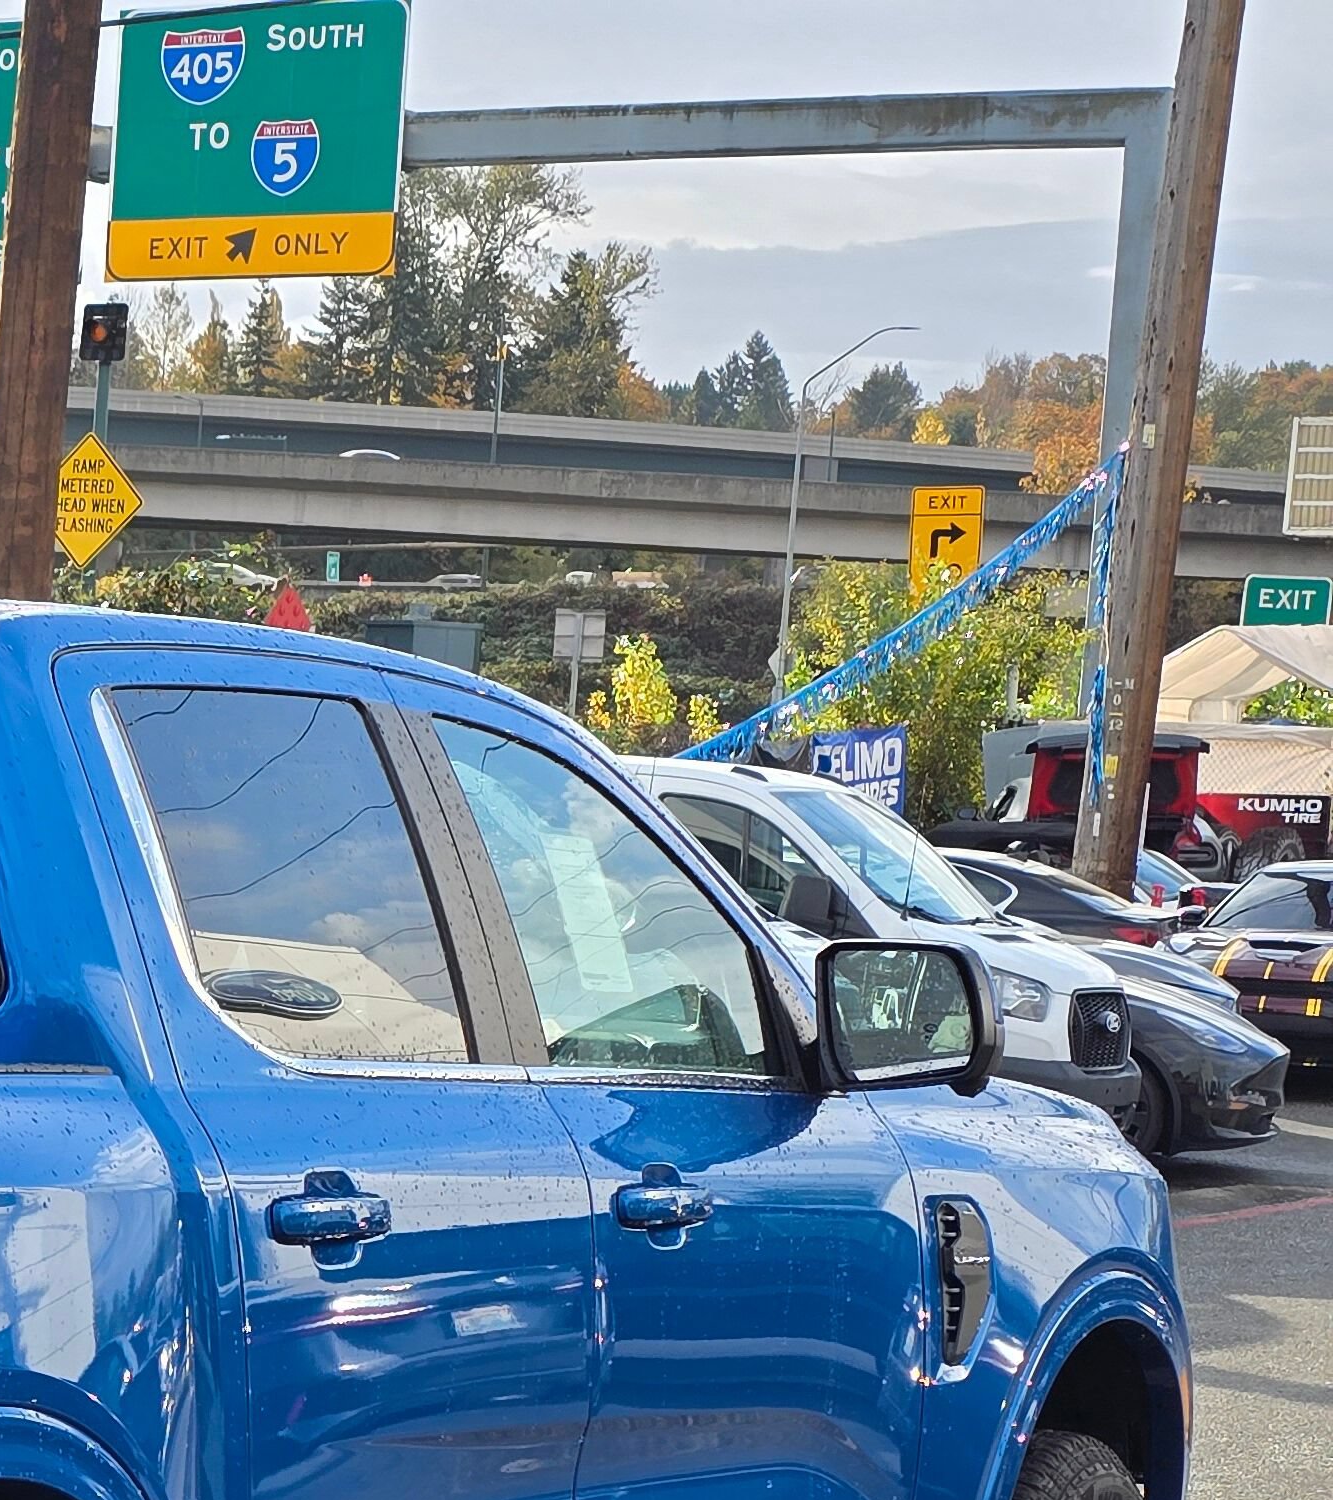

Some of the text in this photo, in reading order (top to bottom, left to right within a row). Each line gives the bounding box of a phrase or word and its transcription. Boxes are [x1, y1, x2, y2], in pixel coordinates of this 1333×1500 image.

[179, 33, 226, 45] INTERSTATE
[266, 24, 365, 52] SOUTH
[170, 51, 234, 87] 405
[189, 121, 230, 151] TO
[263, 124, 310, 136] INTERSTATE
[272, 141, 298, 183] 5
[149, 231, 349, 260] EXIT ONLY
[73, 459, 106, 475] RAMP
[60, 477, 115, 494] METERED
[56, 497, 125, 514] HEAD WHEN
[928, 495, 968, 510] EXIT
[55, 517, 113, 533] FLASHING
[1258, 587, 1317, 611] EXIT
[1237, 797, 1323, 813] KUMHO
[1281, 812, 1322, 825] TIRE
